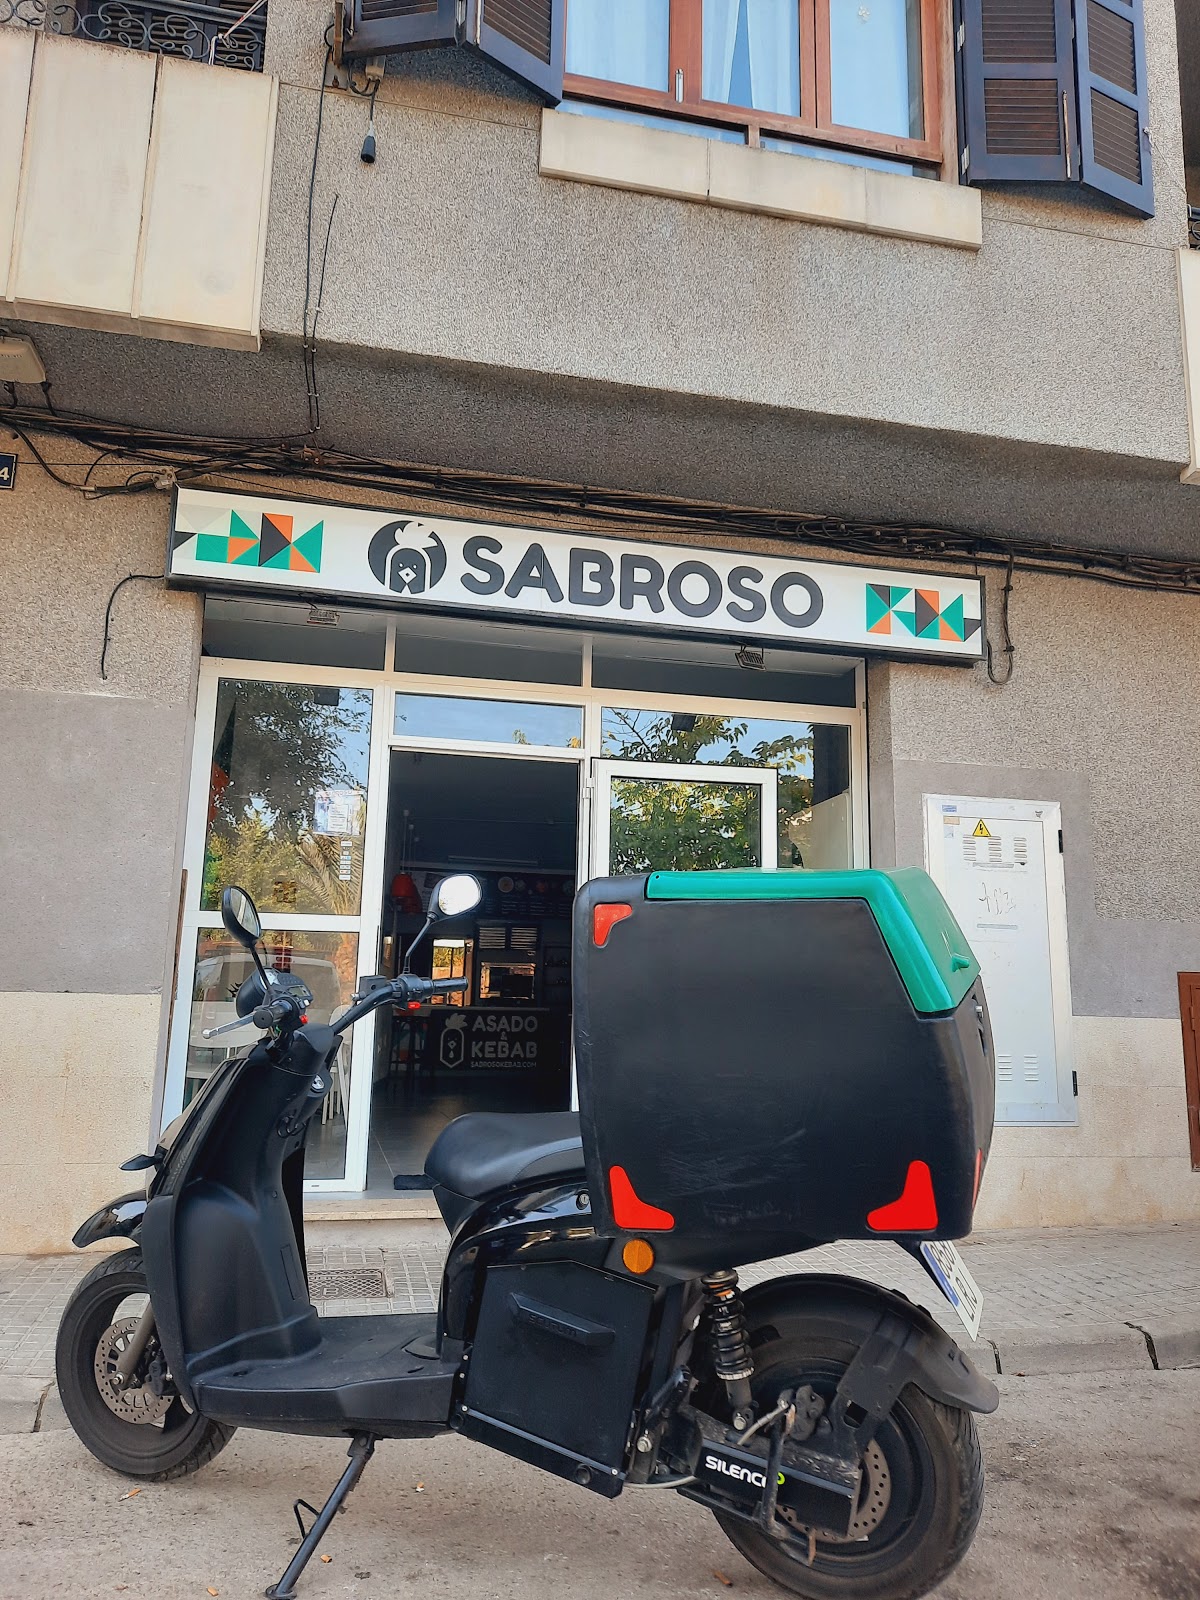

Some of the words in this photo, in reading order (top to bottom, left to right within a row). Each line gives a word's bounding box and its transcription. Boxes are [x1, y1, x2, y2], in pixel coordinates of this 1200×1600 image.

[460, 535, 824, 628] SABROSO
[472, 1015, 538, 1032] ASADO
[500, 1031, 508, 1040] &
[471, 1041, 537, 1058] KEBAB
